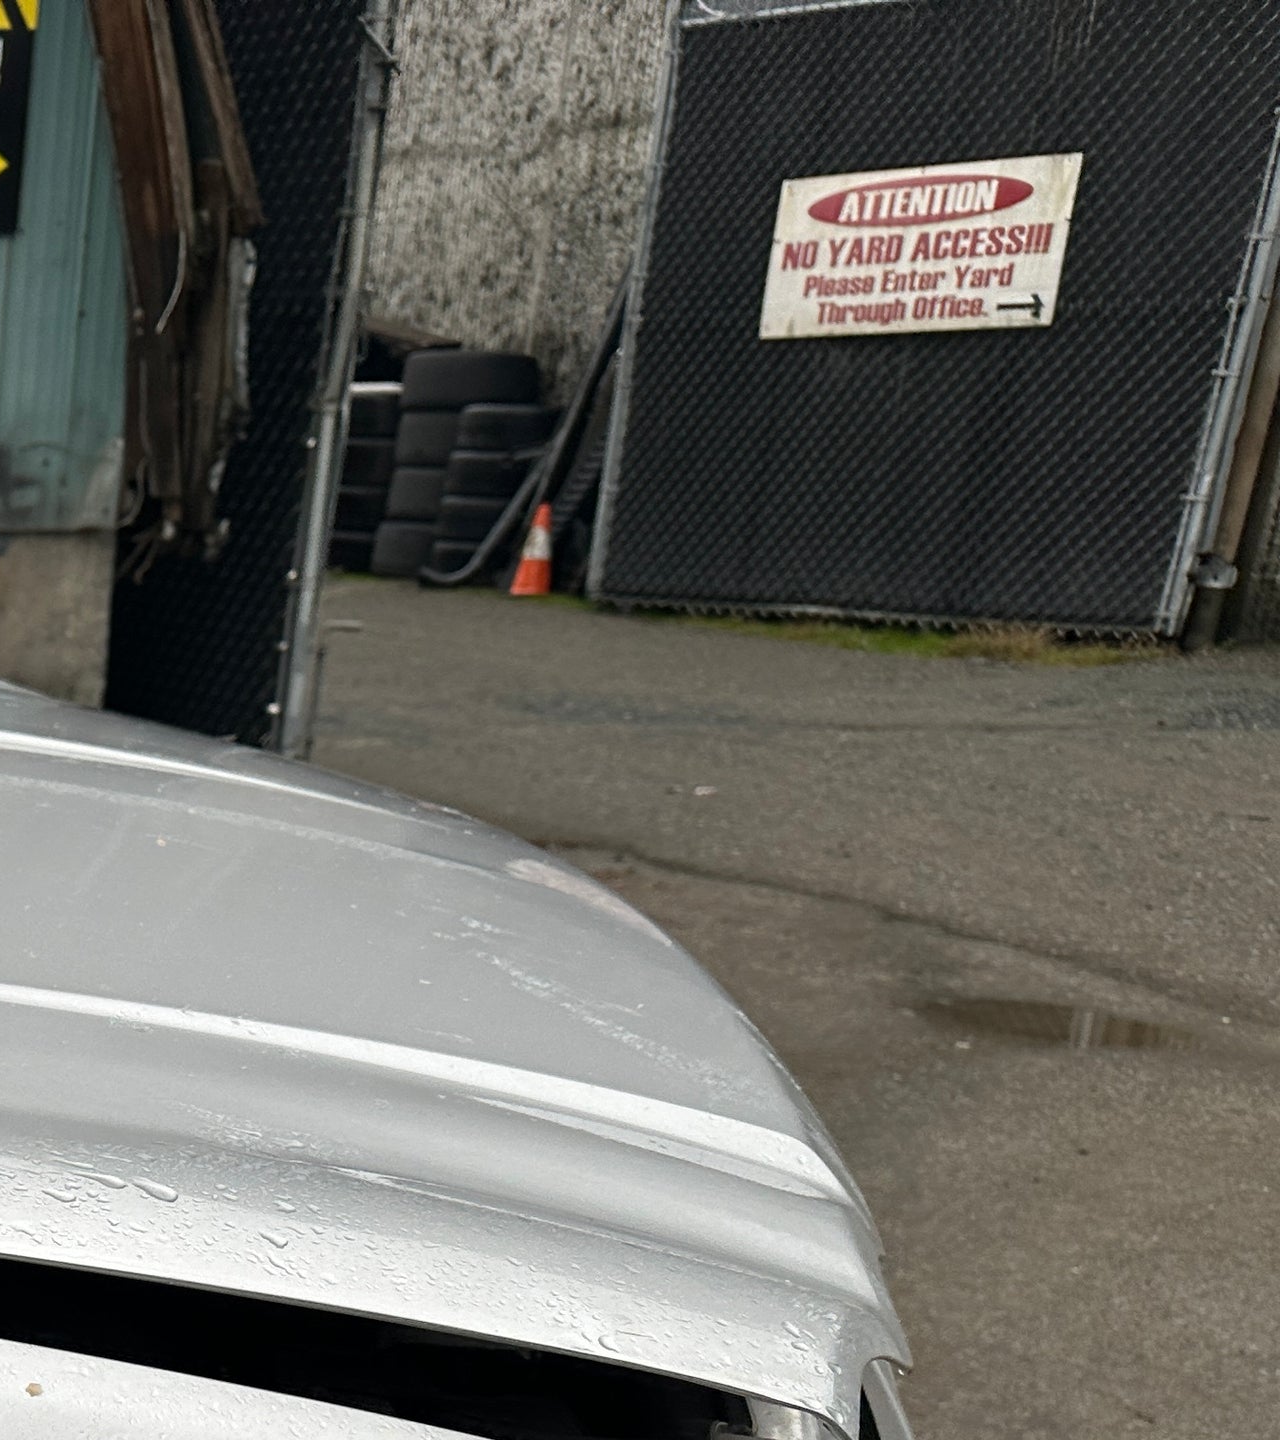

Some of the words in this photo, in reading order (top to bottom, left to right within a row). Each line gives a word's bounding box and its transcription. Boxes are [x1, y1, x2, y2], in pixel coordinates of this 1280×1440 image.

[838, 178, 999, 223] ATTENTION
[781, 242, 817, 271] NO
[828, 233, 904, 268] YARD
[910, 222, 1055, 262] ACCESS!!!
[803, 273, 874, 298] Please
[881, 269, 946, 295] Enter
[954, 263, 1015, 289] Yard
[818, 298, 907, 327] Through
